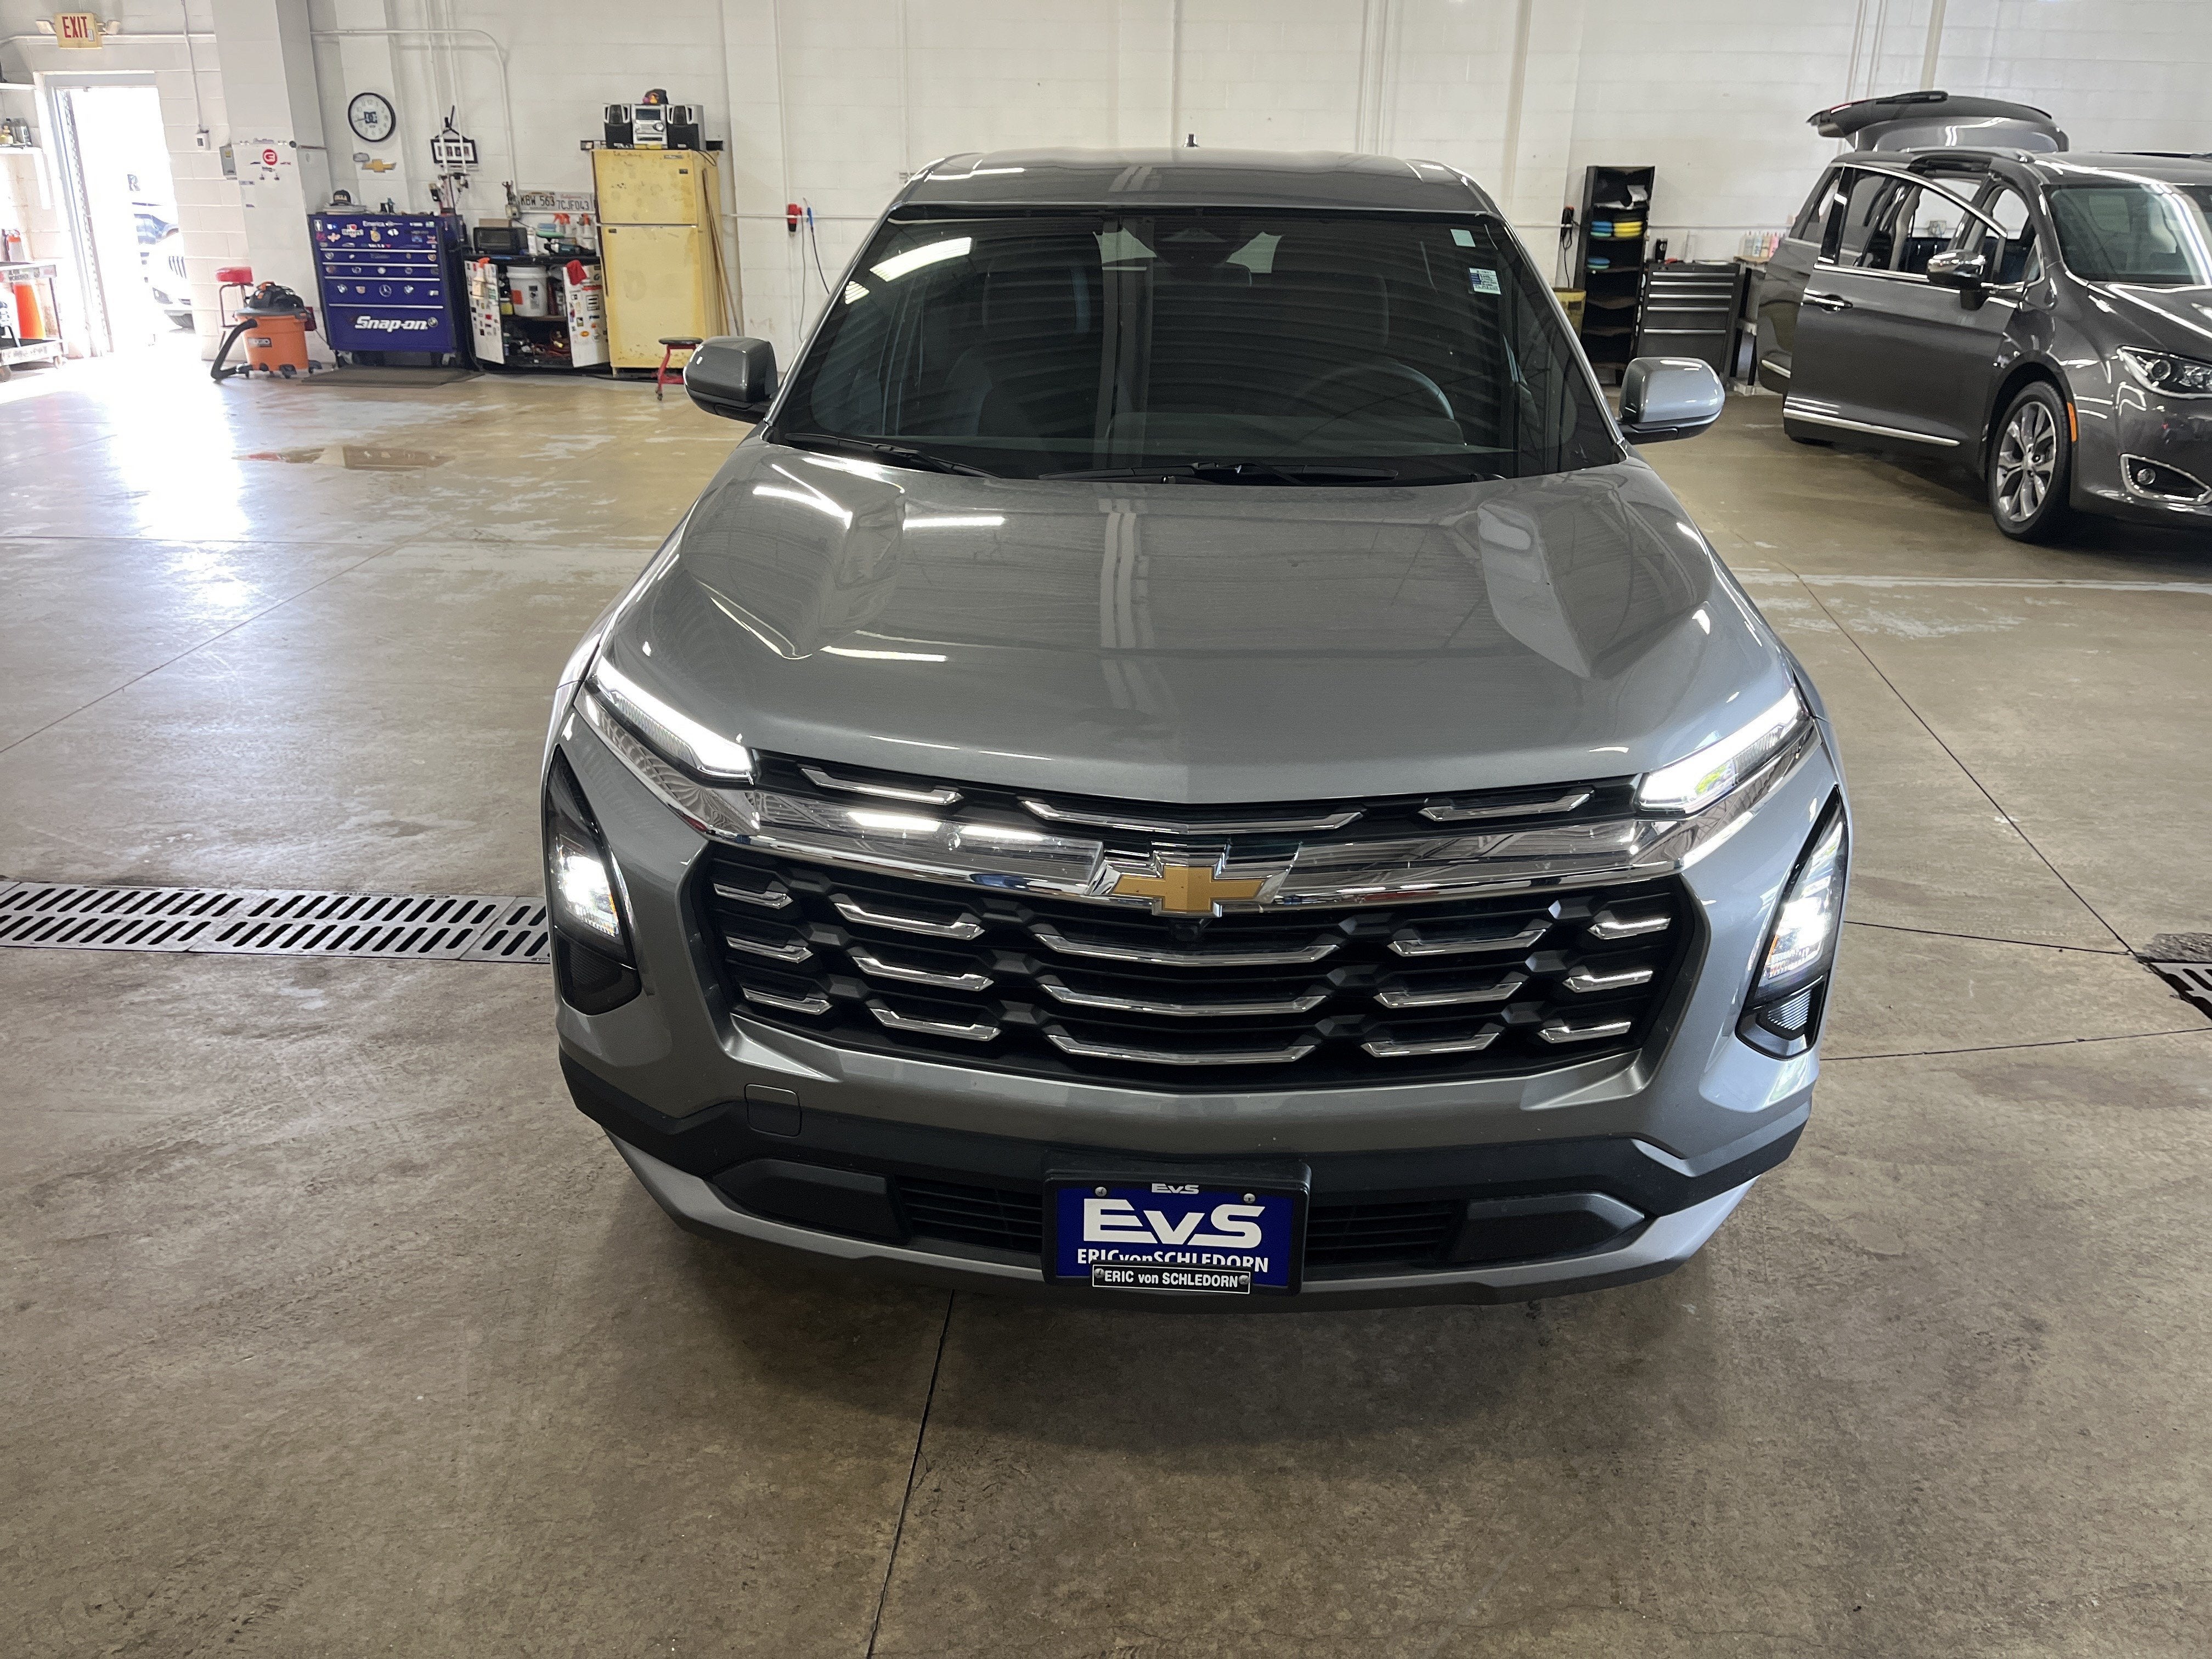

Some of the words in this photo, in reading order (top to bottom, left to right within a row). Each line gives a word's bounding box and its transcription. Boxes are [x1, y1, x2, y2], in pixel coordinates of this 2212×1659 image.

[62, 16, 88, 38] EXIT
[520, 195, 535, 206] KBW
[355, 315, 428, 332] Snap-on
[1104, 1270, 1134, 1283] ERIC
[1138, 1273, 1159, 1284] von
[1162, 1272, 1238, 1288] SCHLEDORN
